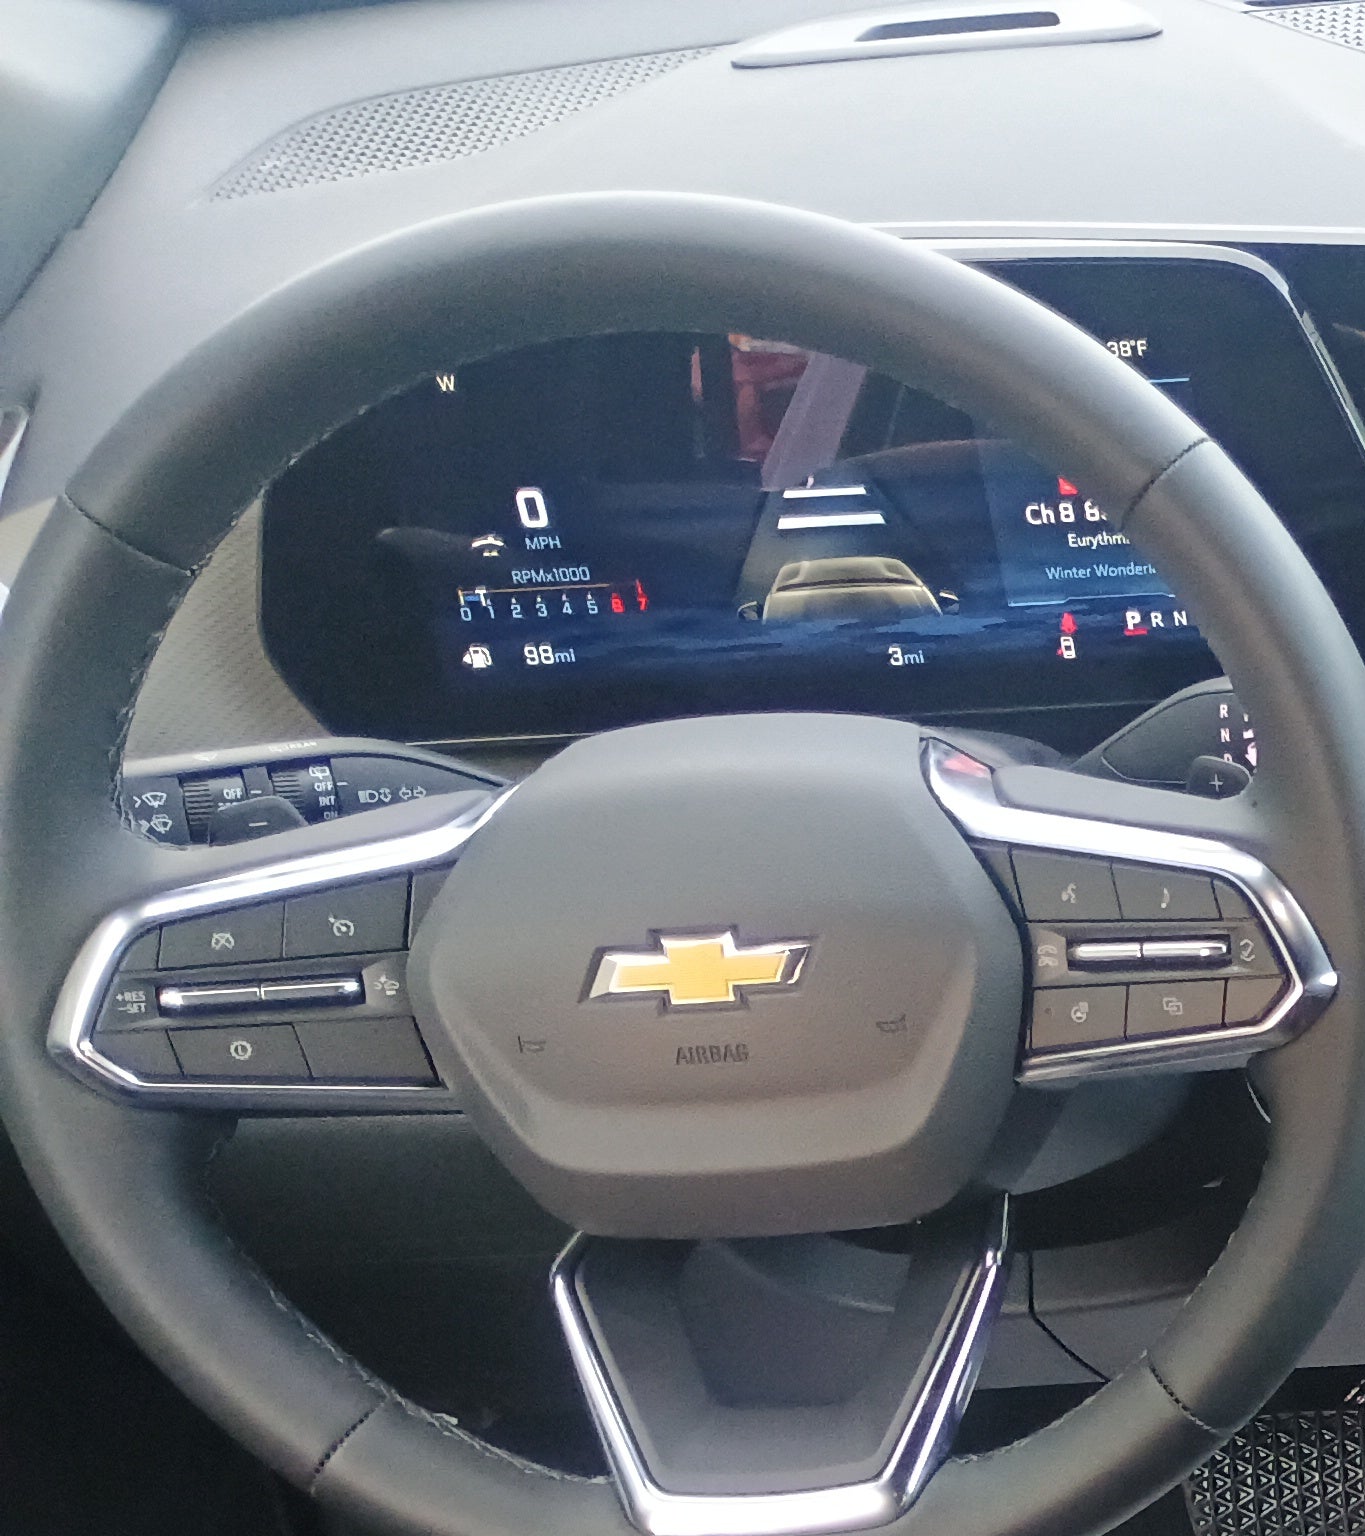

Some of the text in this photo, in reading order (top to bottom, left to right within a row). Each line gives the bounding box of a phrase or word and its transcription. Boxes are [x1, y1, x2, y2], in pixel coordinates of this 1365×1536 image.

[437, 375, 455, 392] W
[516, 489, 548, 528] 0
[1025, 503, 1056, 524] Ch
[1059, 503, 1074, 522] 8
[525, 536, 562, 550] MPH
[1046, 566, 1091, 579] Winter
[460, 608, 472, 621] 0
[511, 605, 523, 618] 2
[536, 604, 547, 617] 3
[562, 603, 573, 614] 4
[588, 601, 598, 614] 5
[1126, 611, 1187, 630] P R N
[1220, 704, 1228, 718] R
[1221, 728, 1230, 742] N
[676, 1043, 749, 1065] AIRBAG
